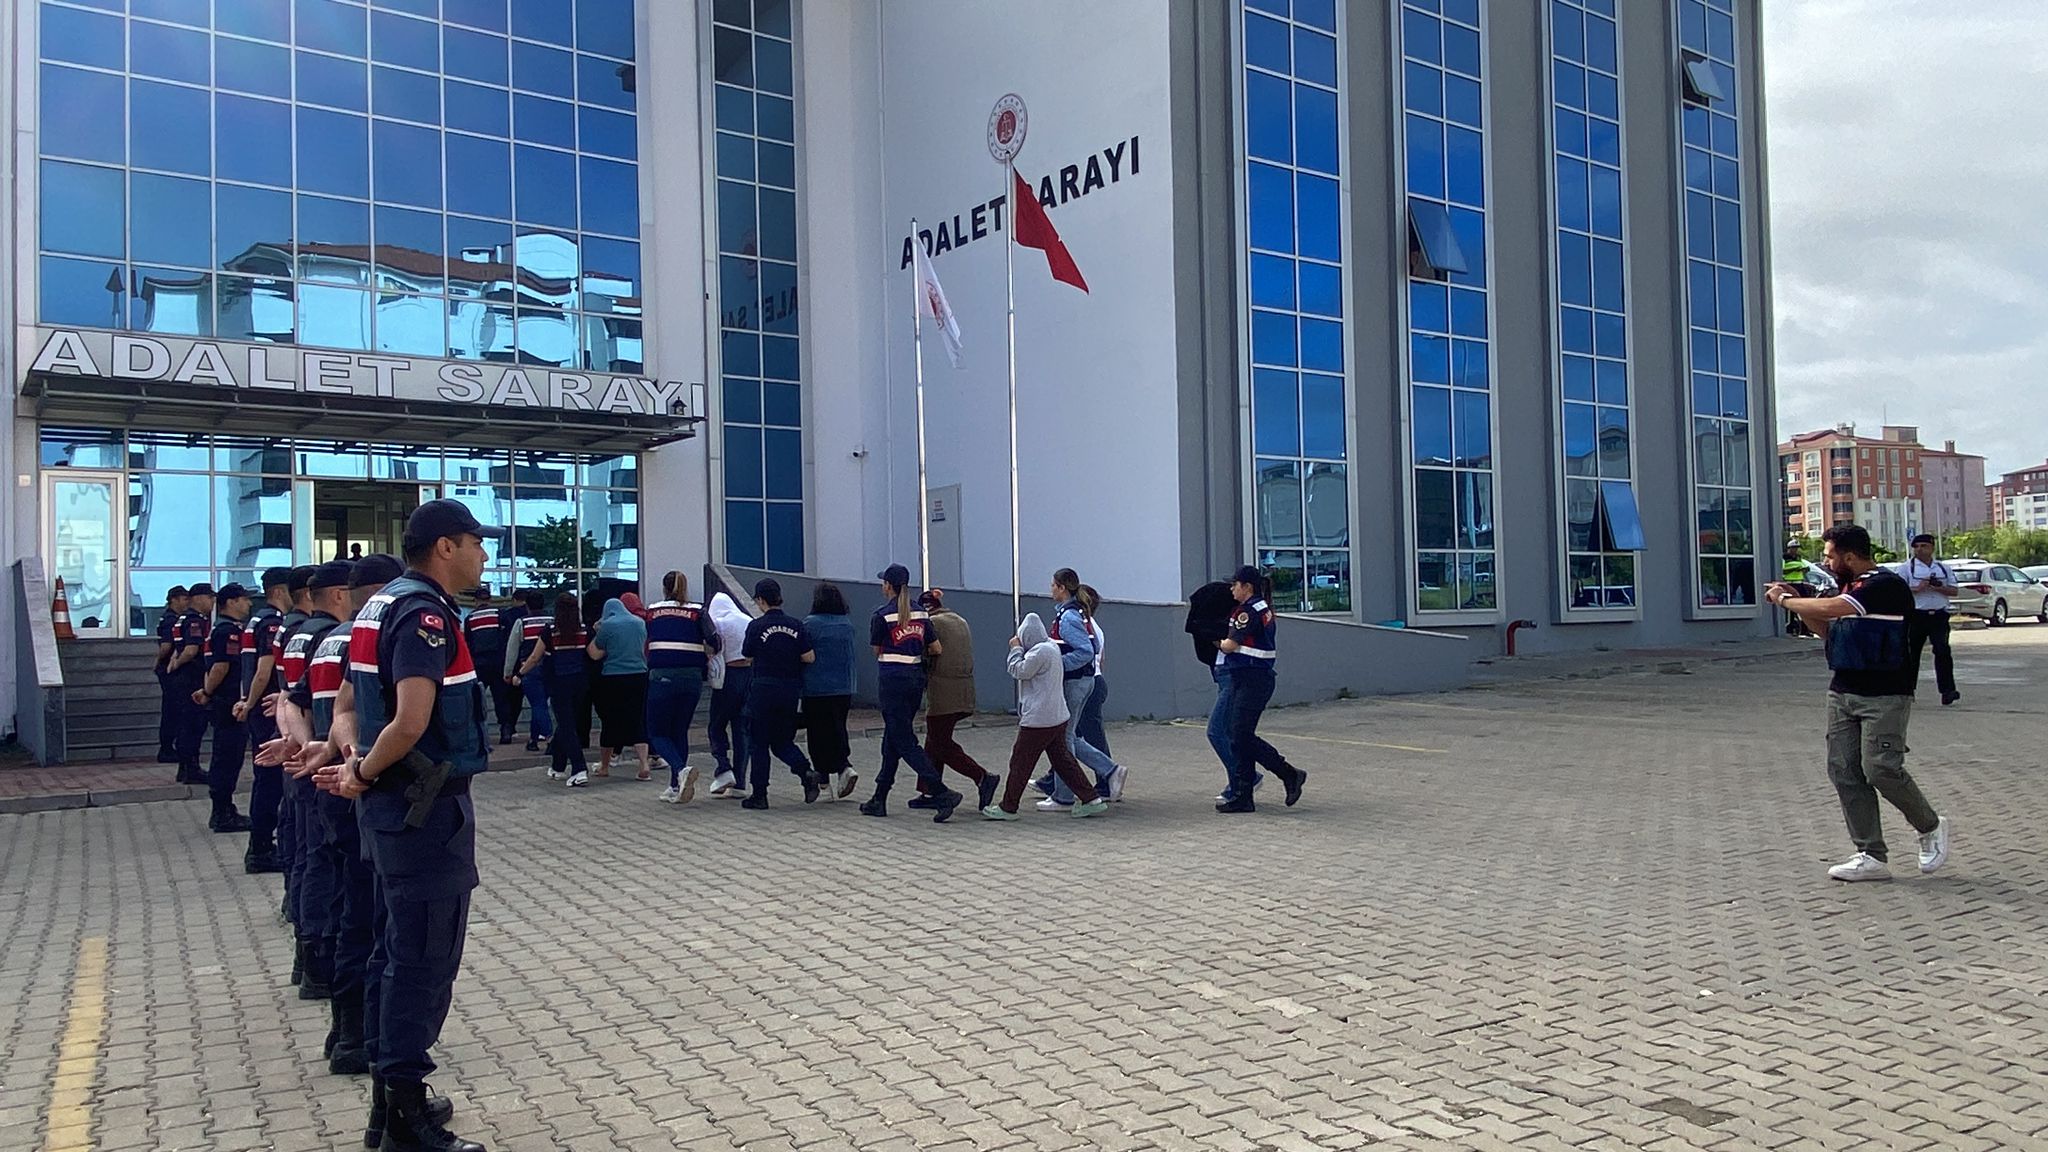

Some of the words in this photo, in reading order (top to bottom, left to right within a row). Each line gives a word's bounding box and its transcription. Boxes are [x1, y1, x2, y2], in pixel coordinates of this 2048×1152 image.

[1037, 135, 1139, 210] ARAYI
[32, 330, 411, 398] ADALET
[437, 363, 705, 417] SARAYI
[760, 625, 798, 642] JANDARMA
